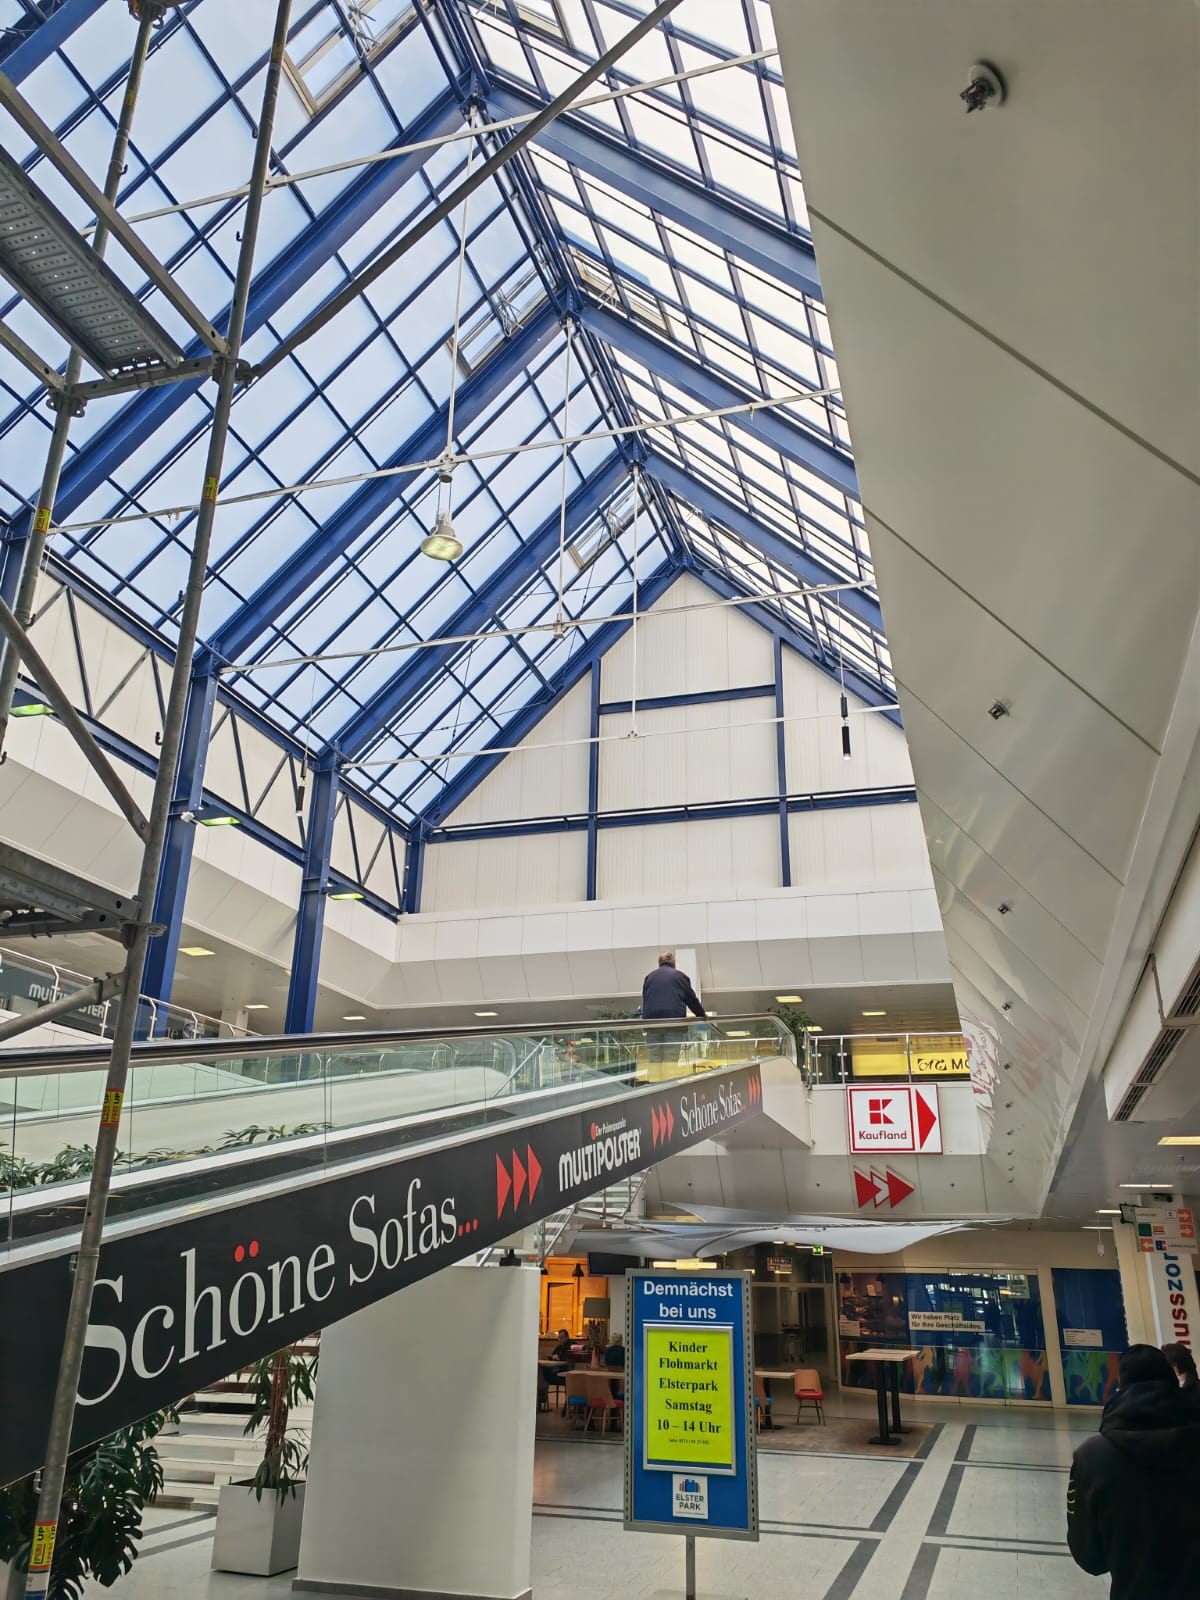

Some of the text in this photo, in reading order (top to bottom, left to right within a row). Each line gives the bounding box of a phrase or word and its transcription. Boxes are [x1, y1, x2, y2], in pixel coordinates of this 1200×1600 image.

[679, 1091, 719, 1138] Schöne
[859, 1130, 907, 1140] Kaufland
[643, 1280, 734, 1297] Demnächst
[660, 1303, 717, 1319] bei uns
[923, 1313, 943, 1321] haben
[75, 1239, 336, 1407] Schöne
[669, 1341, 708, 1353] Kinder
[659, 1357, 718, 1371] Flohmarkt
[659, 1377, 719, 1393] Elsterpark
[665, 1398, 713, 1414] Samstag
[657, 1418, 670, 1431] 10
[683, 1420, 695, 1432] 14
[699, 1421, 721, 1434] Uhr
[675, 1494, 705, 1503] ELSTER
[679, 1502, 701, 1511] PARK
[37, 1526, 45, 1541] UP
